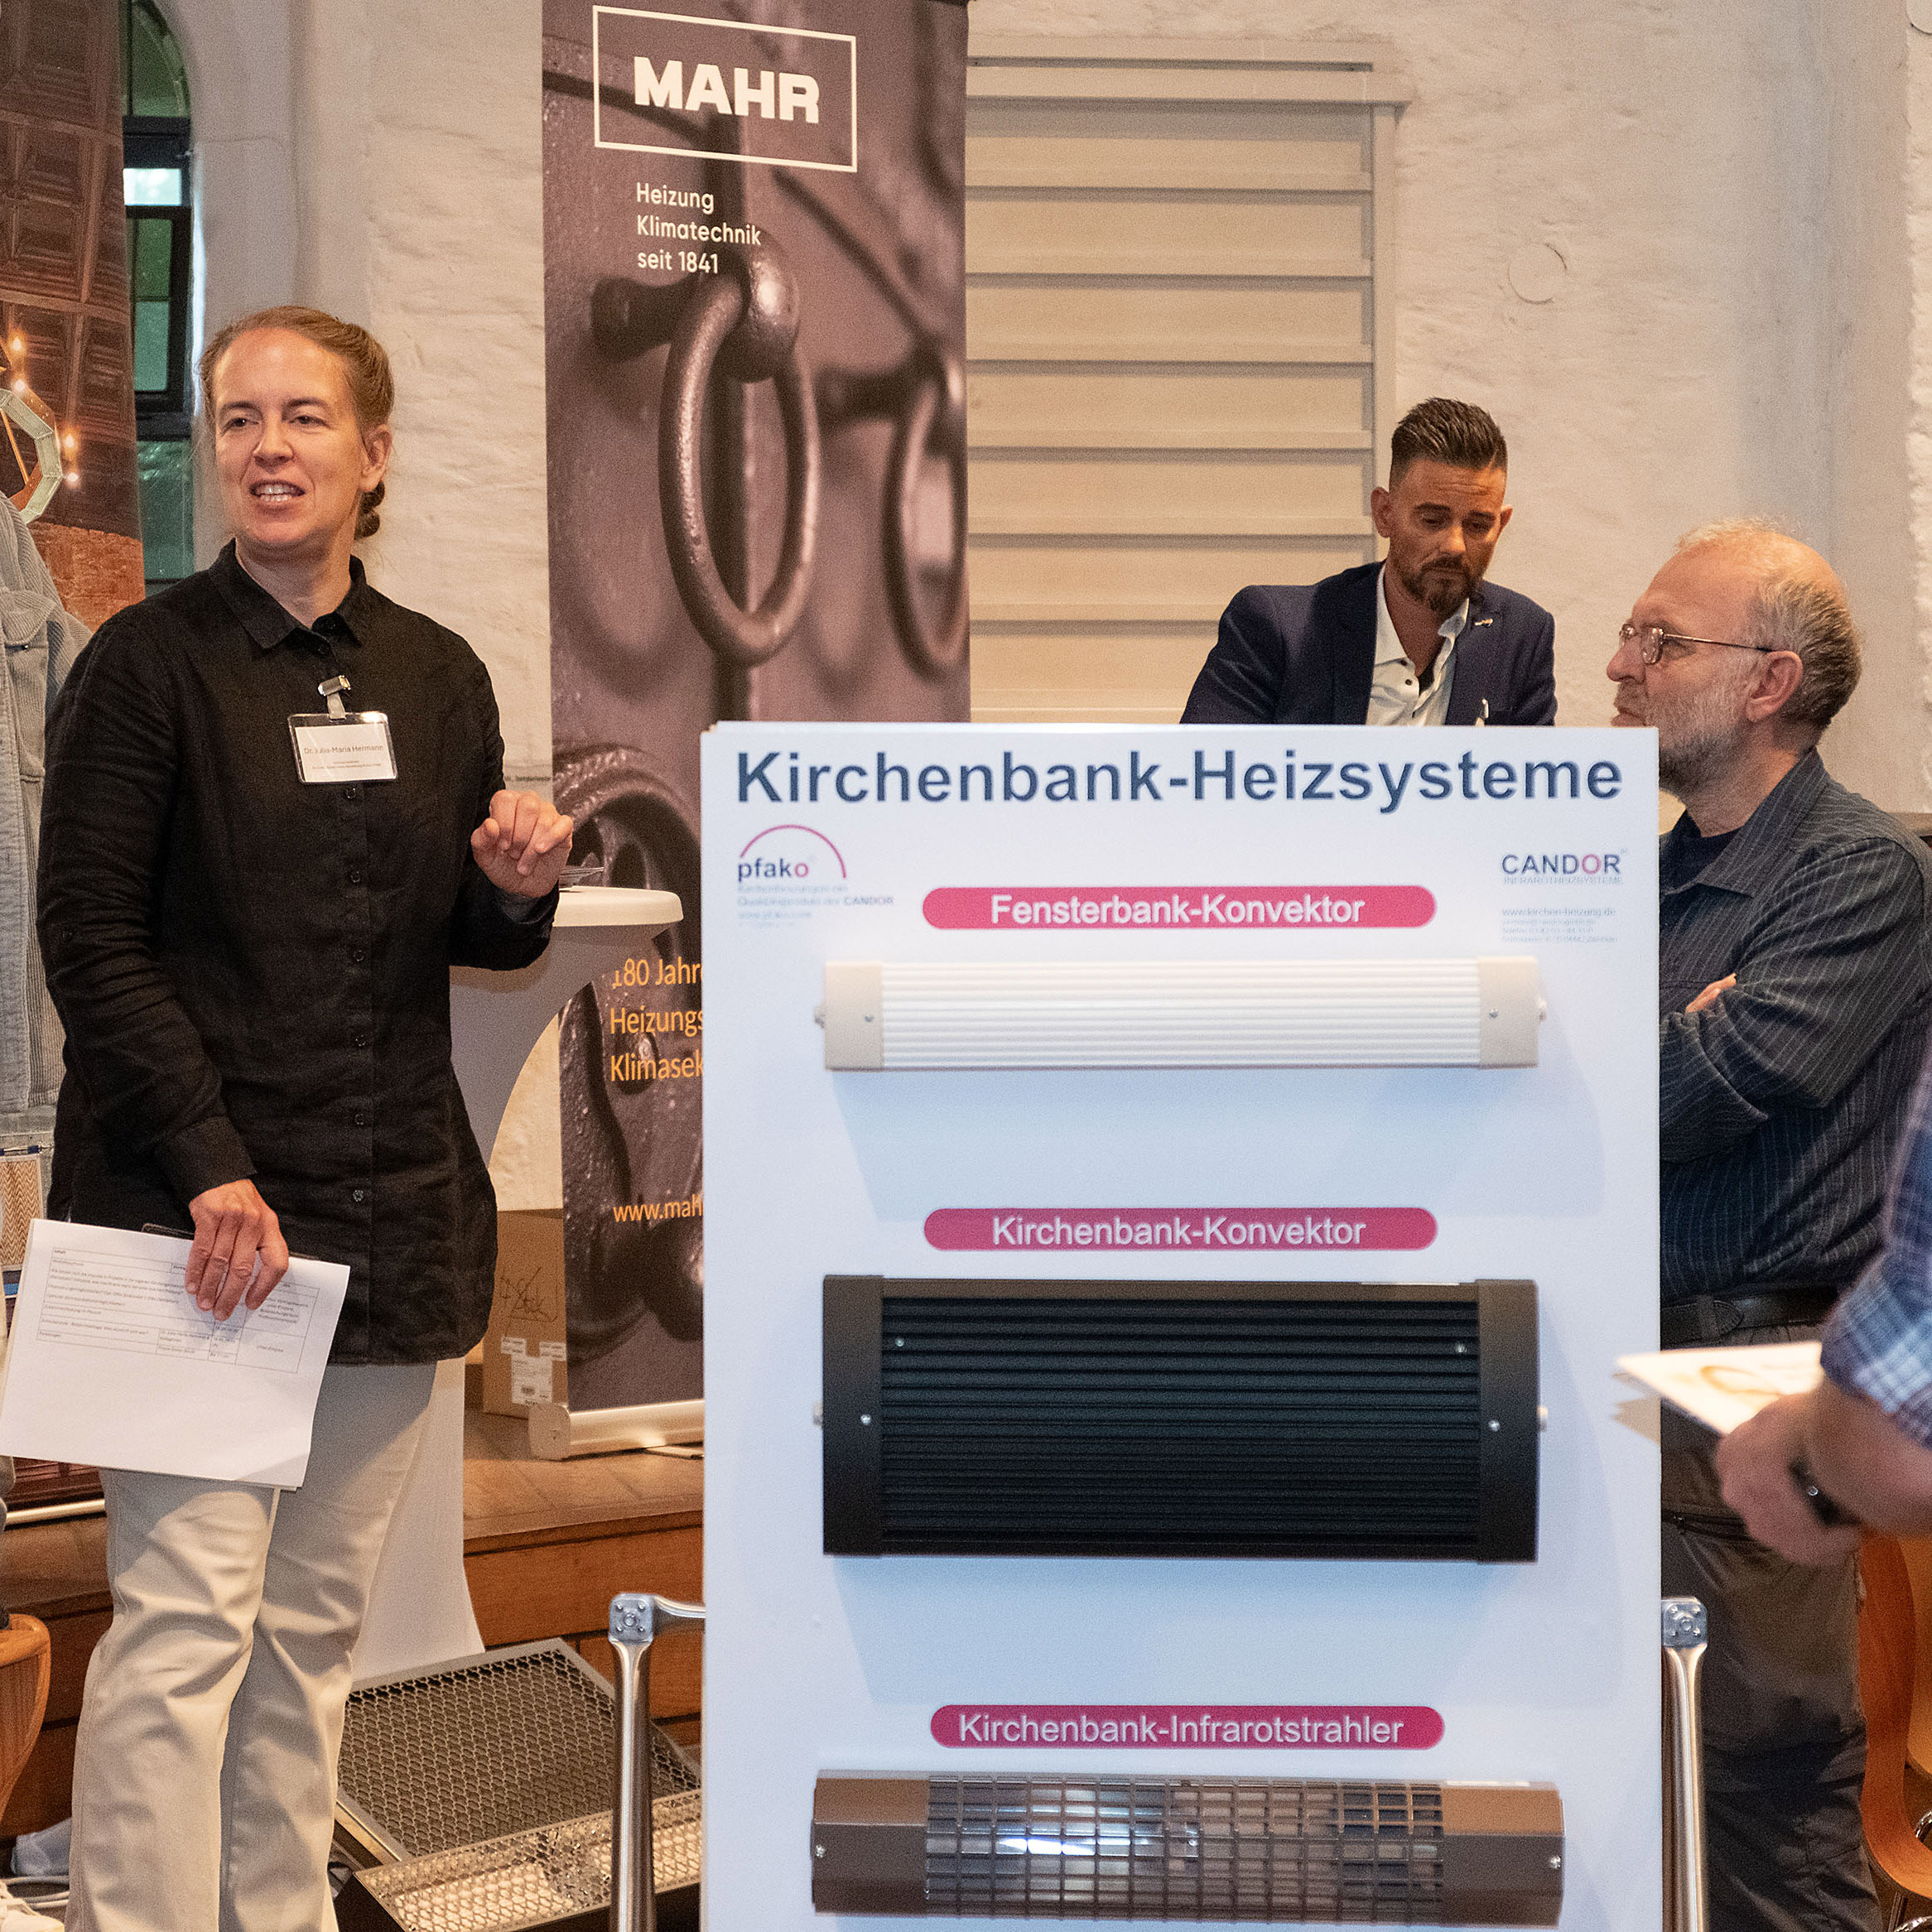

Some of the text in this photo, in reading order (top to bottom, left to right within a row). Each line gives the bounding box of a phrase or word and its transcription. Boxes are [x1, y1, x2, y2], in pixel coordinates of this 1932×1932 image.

[634, 55, 819, 124] MAHR
[637, 181, 714, 214] Heizung
[637, 214, 761, 246] Klimatechnik
[637, 249, 719, 274] seit 1841
[737, 750, 1622, 814] Kirchenbank-Heizsysteme
[738, 858, 809, 883] pfako
[1501, 854, 1621, 874] CANDOR
[991, 894, 1366, 924] Fensterbank-Konvektor
[655, 956, 702, 985] Jahr
[993, 1217, 1366, 1245] Kirchenbank-Konvektor
[959, 1714, 1404, 1744] Kirchenbank-Infrarotstrahler
